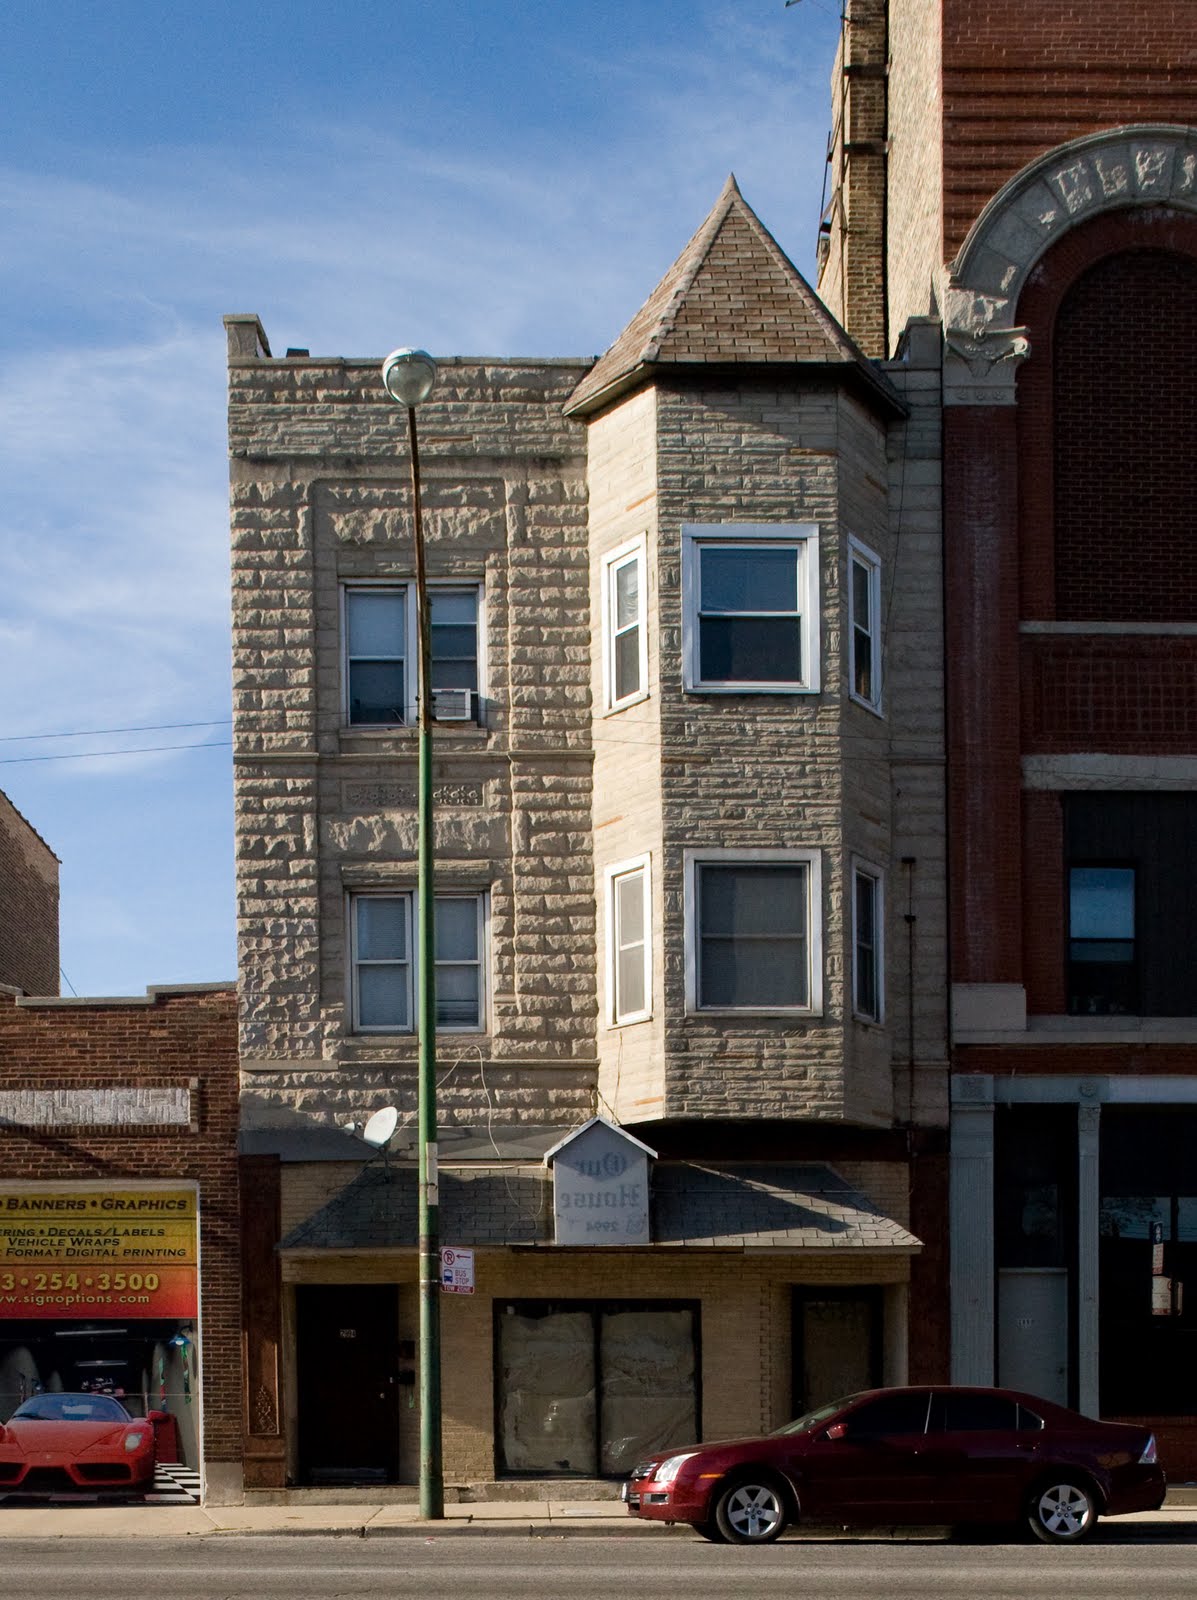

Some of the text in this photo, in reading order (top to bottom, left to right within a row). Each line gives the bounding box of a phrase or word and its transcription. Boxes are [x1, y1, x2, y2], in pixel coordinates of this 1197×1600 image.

[6, 1198, 187, 1211] BANNERS GRAPHICS
[8, 1237, 120, 1246] VEHICLE WRAPS
[6, 1247, 186, 1257] FORMAT DIGITAL PRINTING
[455, 1277, 469, 1285] STOP
